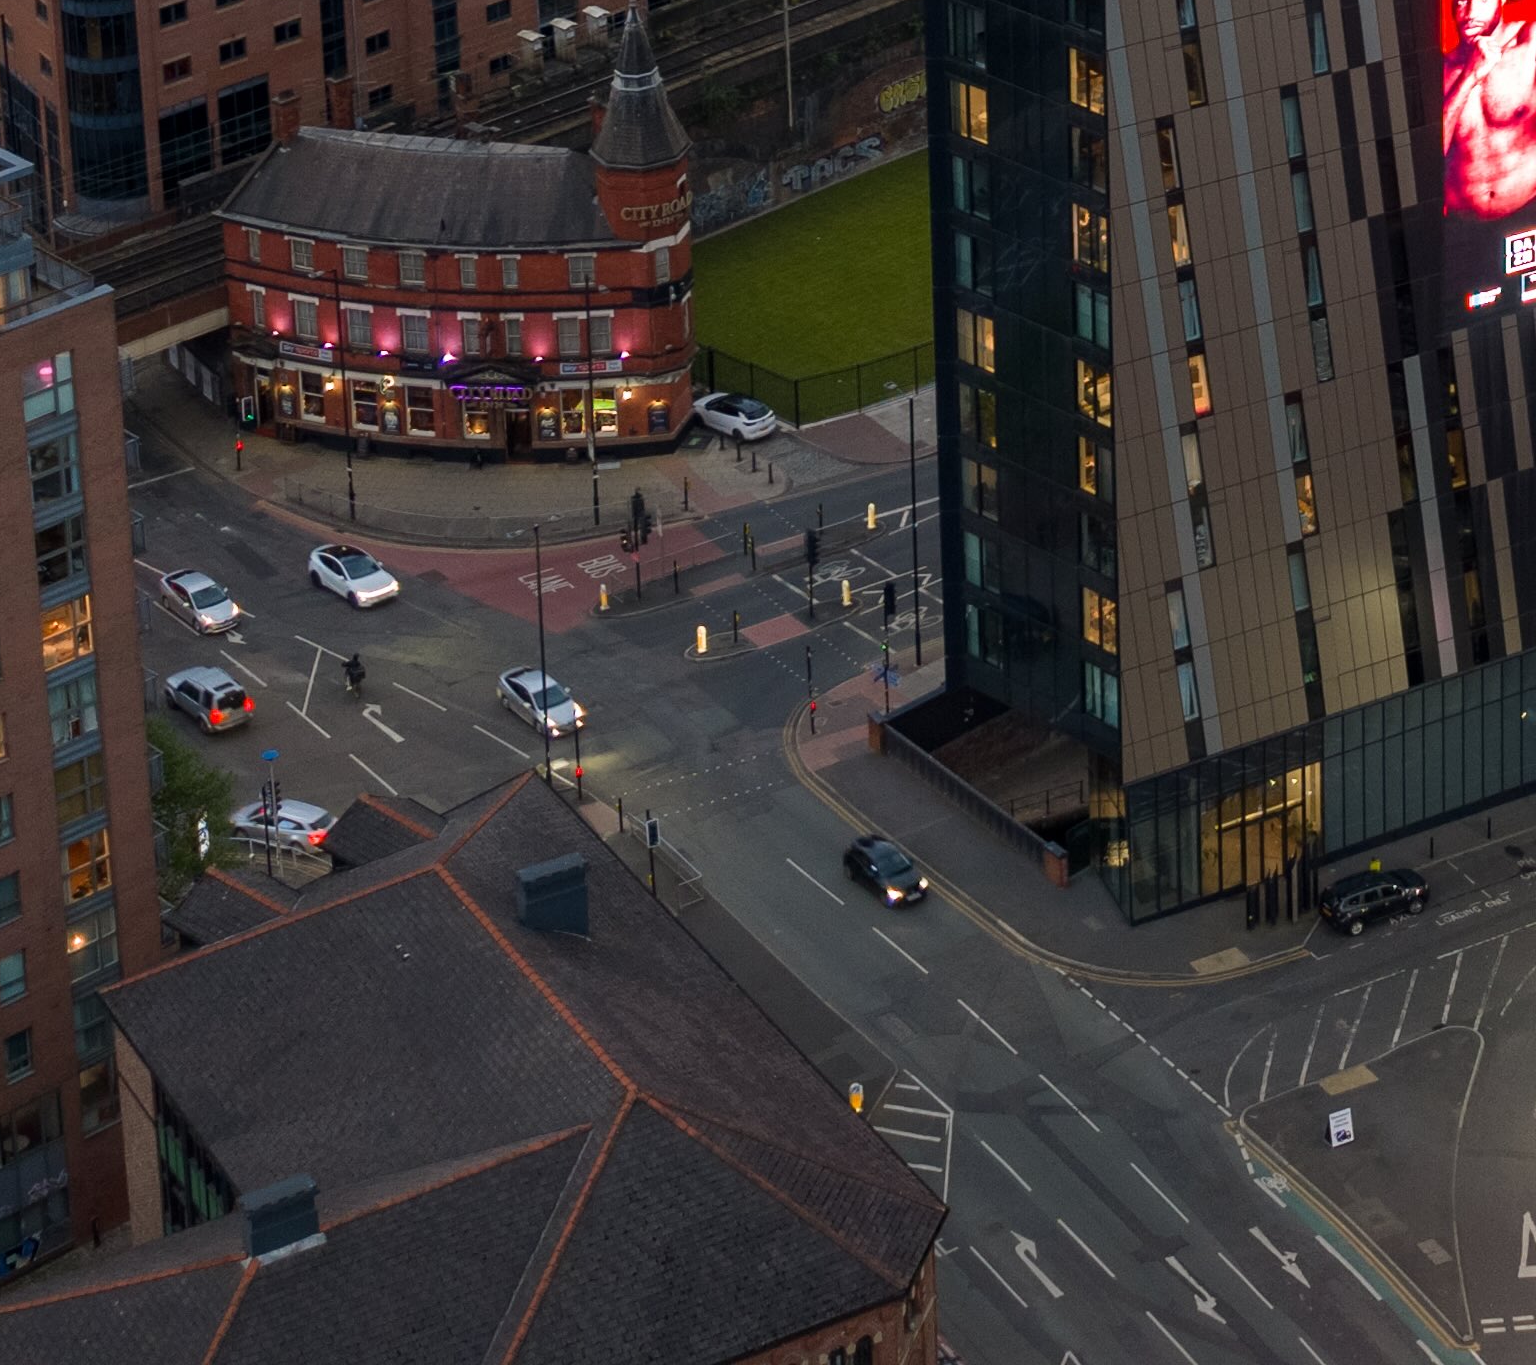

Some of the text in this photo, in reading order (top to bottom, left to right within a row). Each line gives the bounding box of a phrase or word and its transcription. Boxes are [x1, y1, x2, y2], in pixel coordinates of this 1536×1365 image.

[620, 205, 659, 221] CITY
[662, 190, 693, 217] ROAD
[577, 554, 626, 578] BUS
[518, 567, 575, 596] LANE
[1435, 905, 1483, 927] LOADING
[1485, 894, 1513, 909] ONLY
